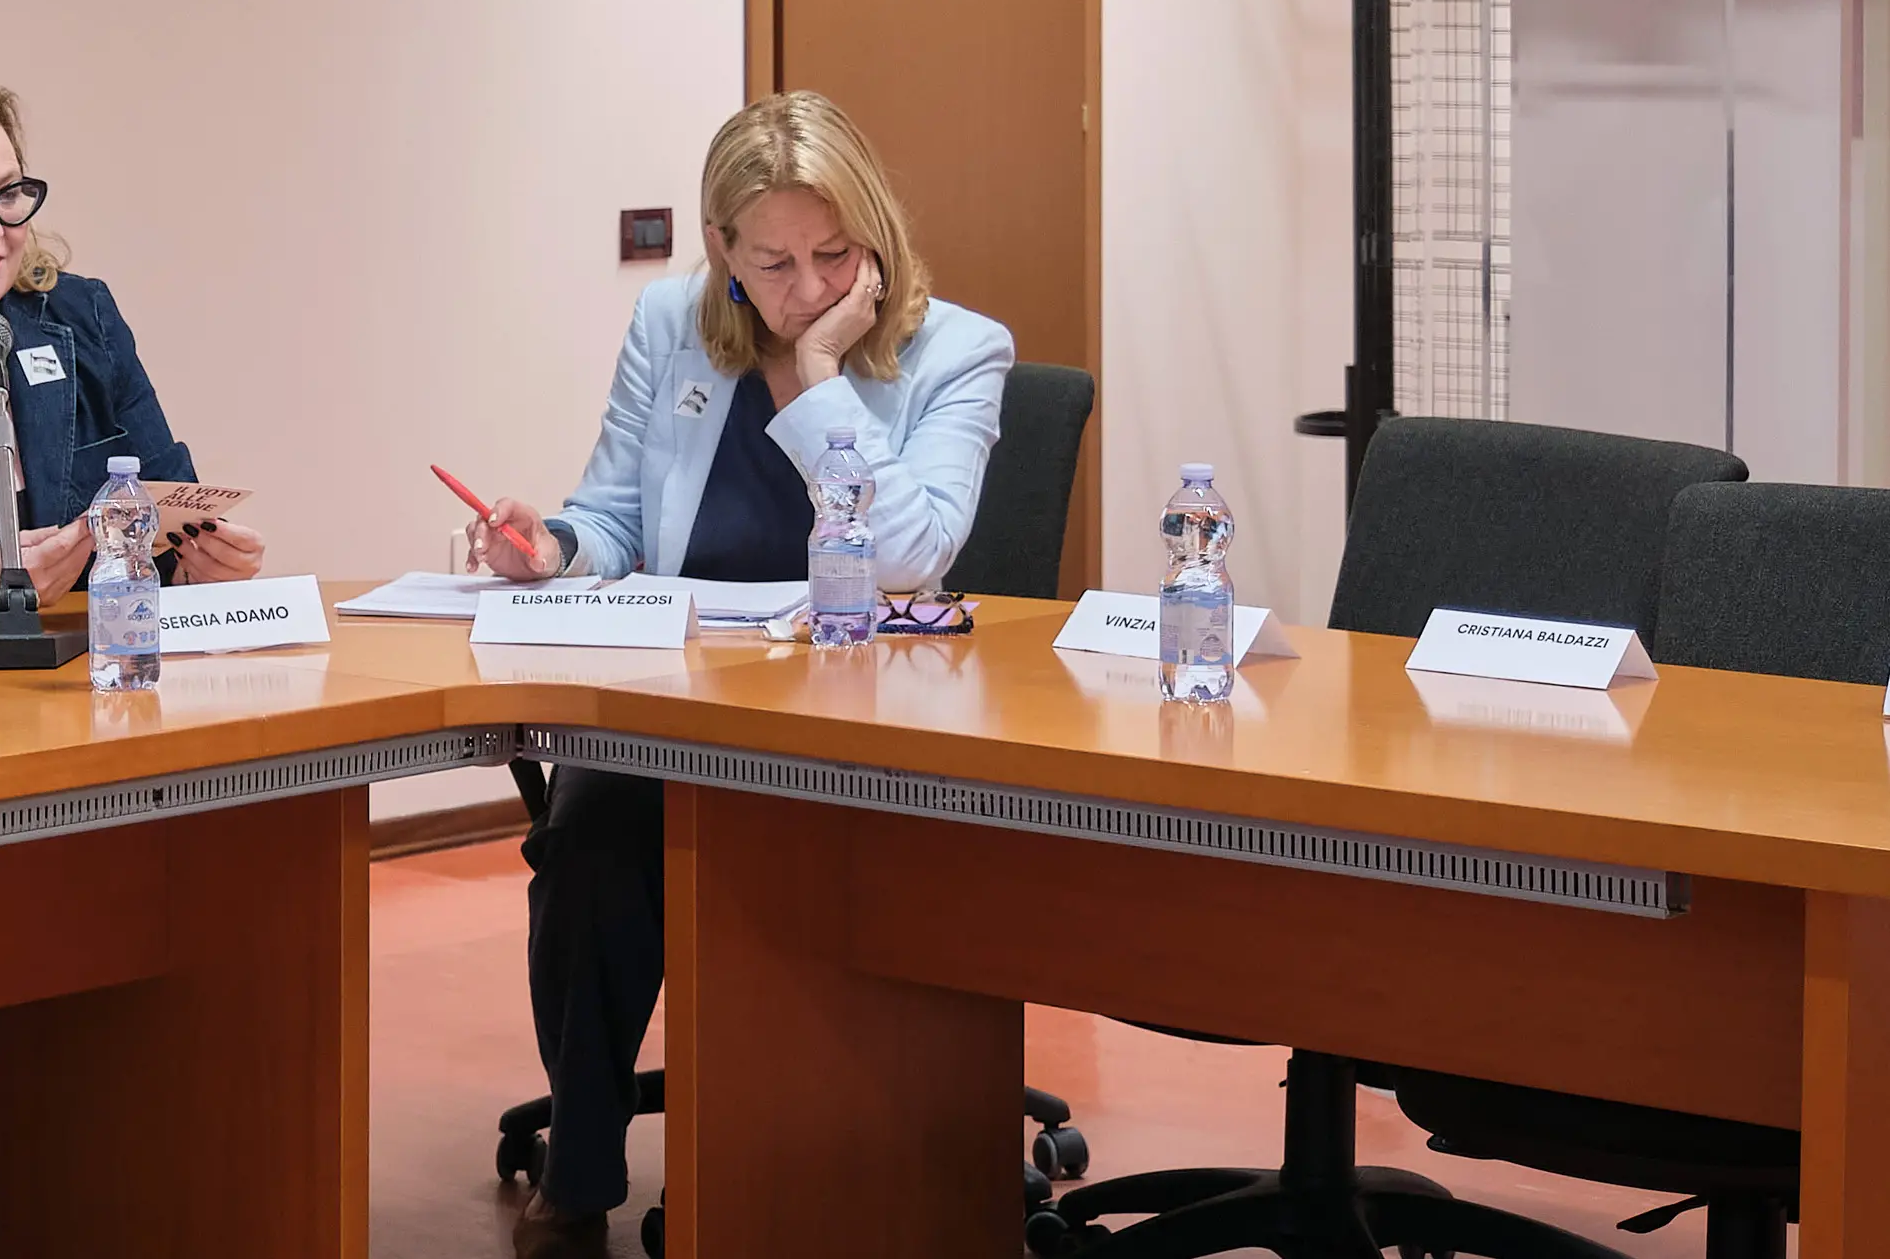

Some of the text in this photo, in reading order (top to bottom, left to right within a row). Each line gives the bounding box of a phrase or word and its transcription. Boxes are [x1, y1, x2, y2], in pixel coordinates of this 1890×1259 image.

[163, 493, 209, 503] ALLE
[195, 487, 241, 499] VOTO
[156, 500, 218, 512] DONNE
[512, 594, 673, 606] ELISABETTA VEZZOSI
[159, 605, 289, 631] SERGIA ADAMO
[1104, 614, 1157, 632] VINZIA
[1457, 623, 1610, 649] CRISTIANA BALDAZZI
